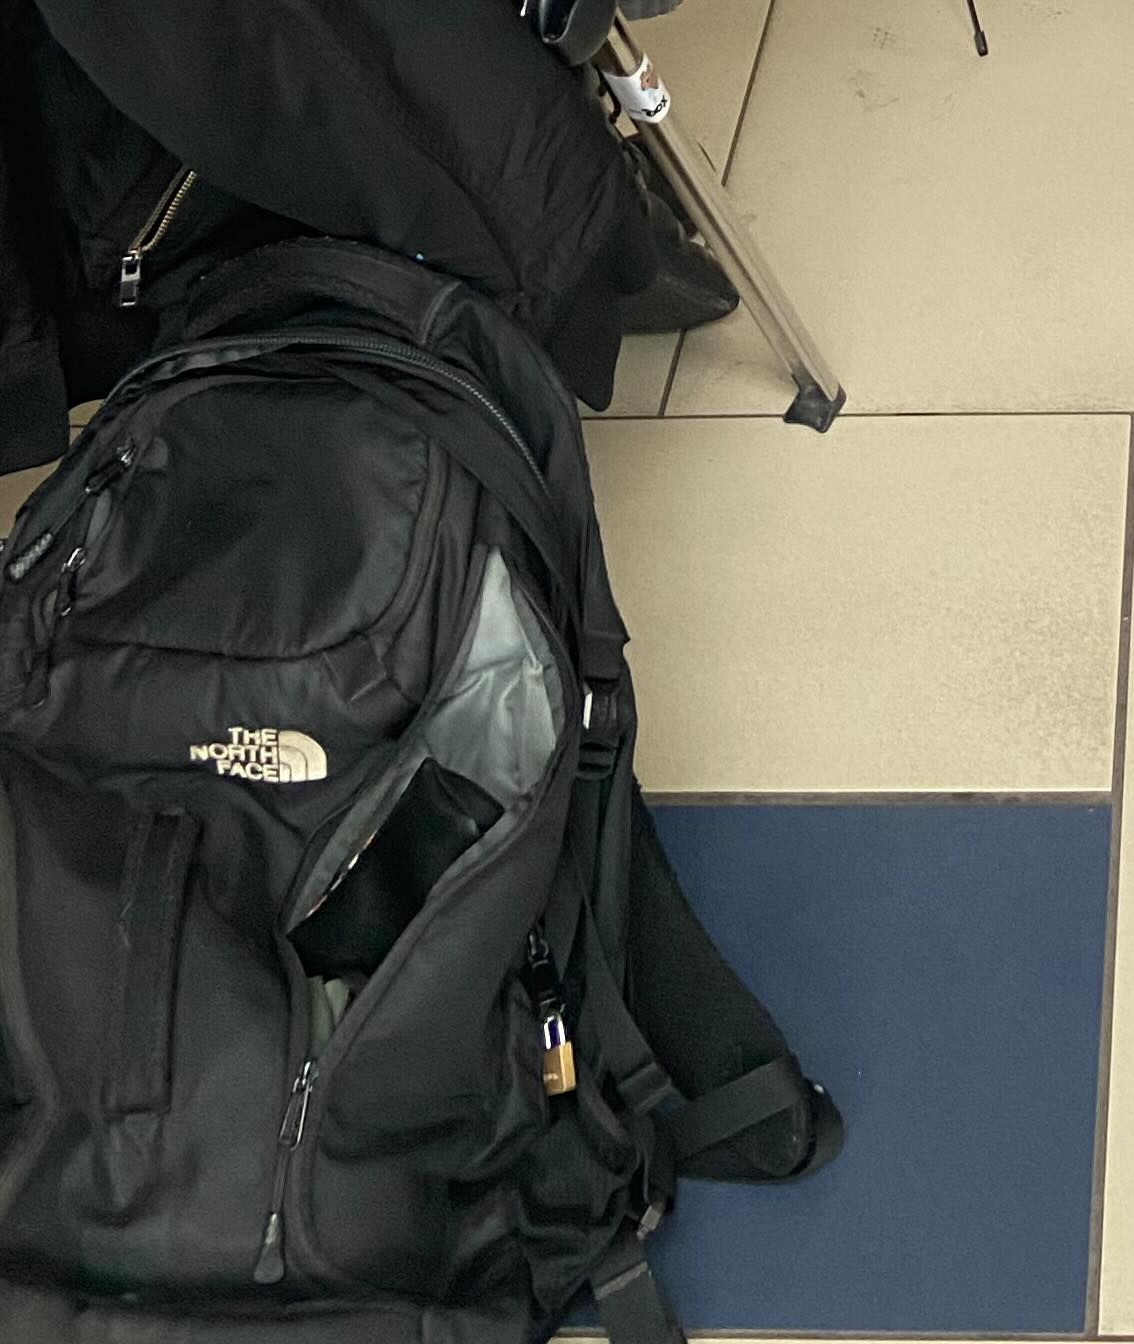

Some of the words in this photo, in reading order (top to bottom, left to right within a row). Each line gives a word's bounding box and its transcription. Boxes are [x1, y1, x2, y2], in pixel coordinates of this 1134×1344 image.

[228, 726, 278, 746] THE
[189, 742, 278, 765] NORTH
[216, 760, 280, 783] FACE
